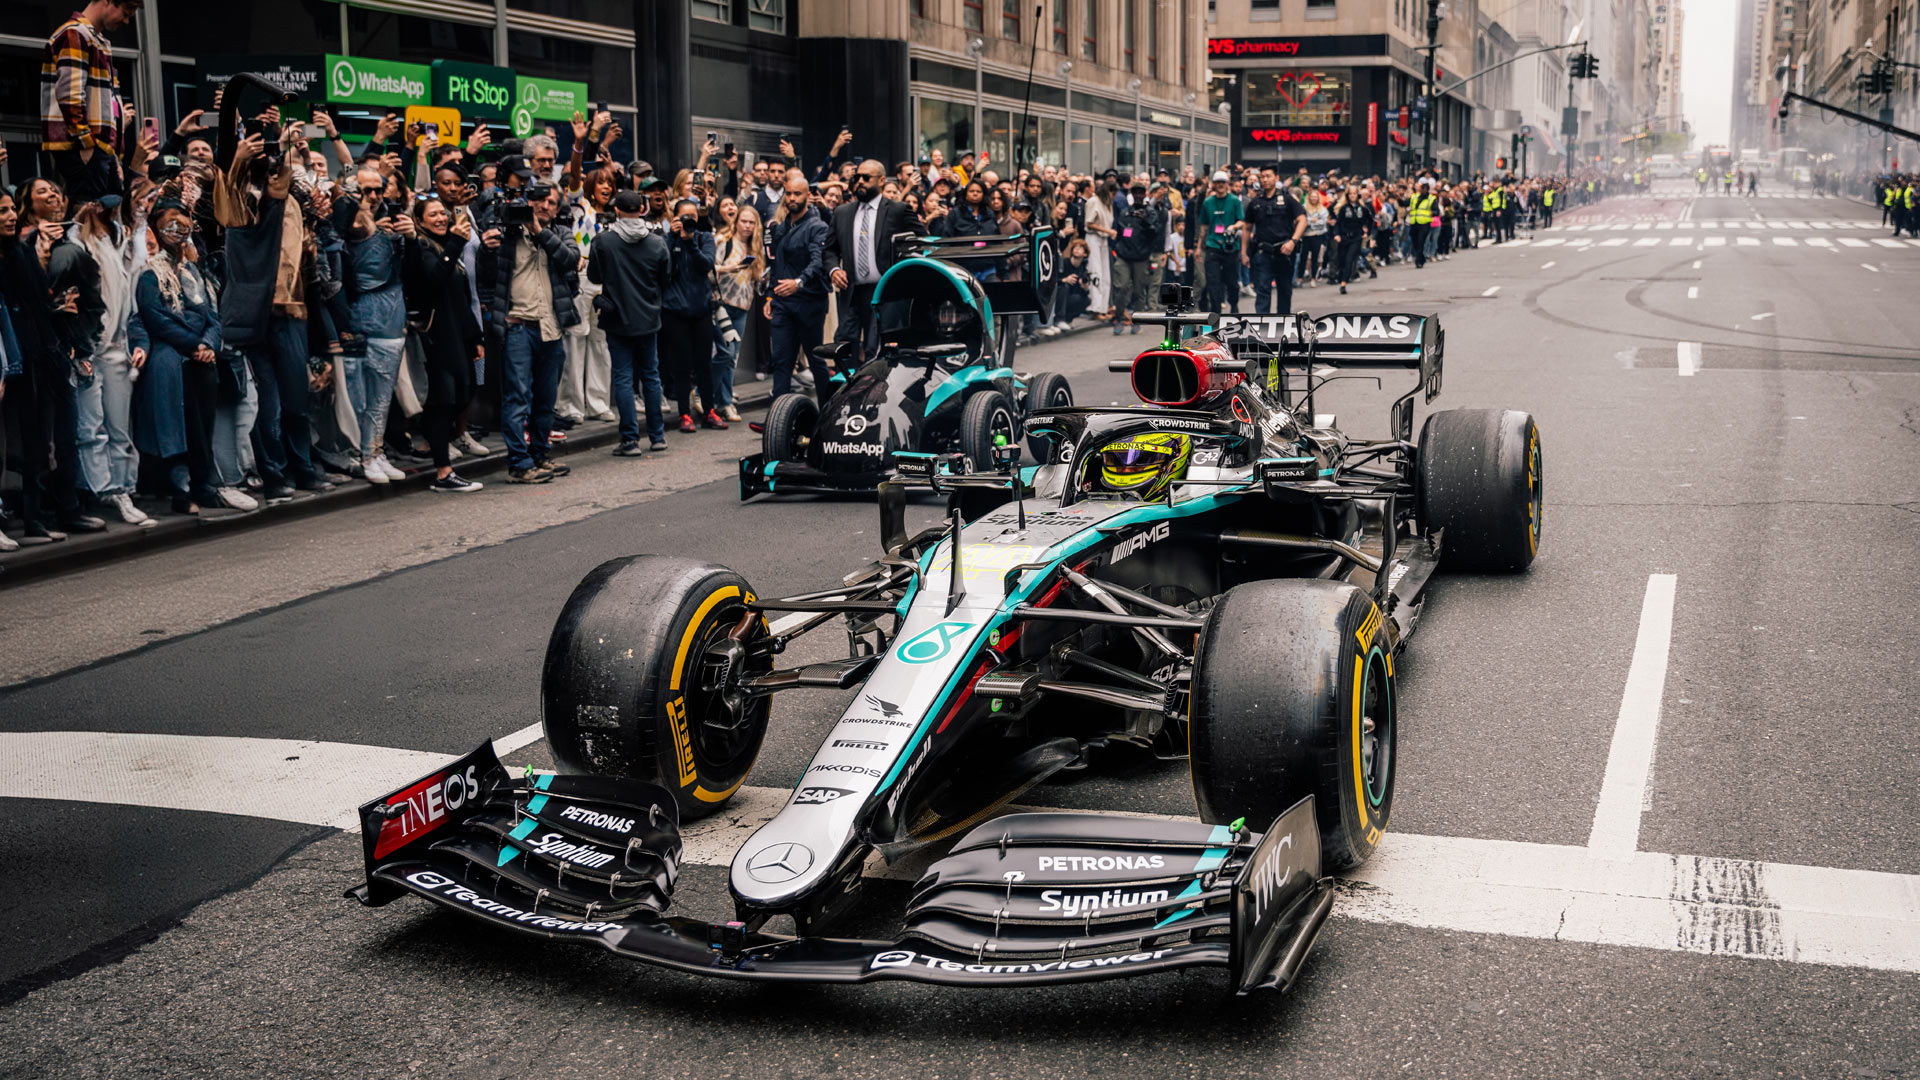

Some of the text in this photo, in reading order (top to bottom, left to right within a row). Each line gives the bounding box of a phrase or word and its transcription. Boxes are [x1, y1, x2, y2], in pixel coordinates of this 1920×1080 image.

[1236, 41, 1300, 56] pharmacy
[289, 72, 317, 83] STATE
[358, 71, 425, 99] WhatsApp
[450, 76, 509, 111] Pit Stop
[1264, 129, 1340, 143] CVS pharmacy
[1153, 419, 1210, 430] CROWDSTRIKE
[823, 441, 884, 457] WhatsApp
[898, 464, 926, 472] PETRONAS
[1267, 470, 1305, 479] PETRONAS
[1125, 521, 1170, 553] AMG
[842, 718, 913, 729] CROWDSTRIKE
[666, 696, 697, 788] PIRELLI
[831, 740, 889, 752] PIRELLI
[401, 764, 479, 838] INEOS
[797, 789, 841, 803] SAP
[560, 805, 636, 833] PETRONAS
[527, 833, 615, 869] Syntium
[1038, 855, 1165, 871] PETRONAS
[1252, 833, 1292, 926] IWC
[443, 883, 624, 933] TeamViewer
[1039, 889, 1168, 917] Syntium
[919, 948, 1173, 974] TeamViewer
